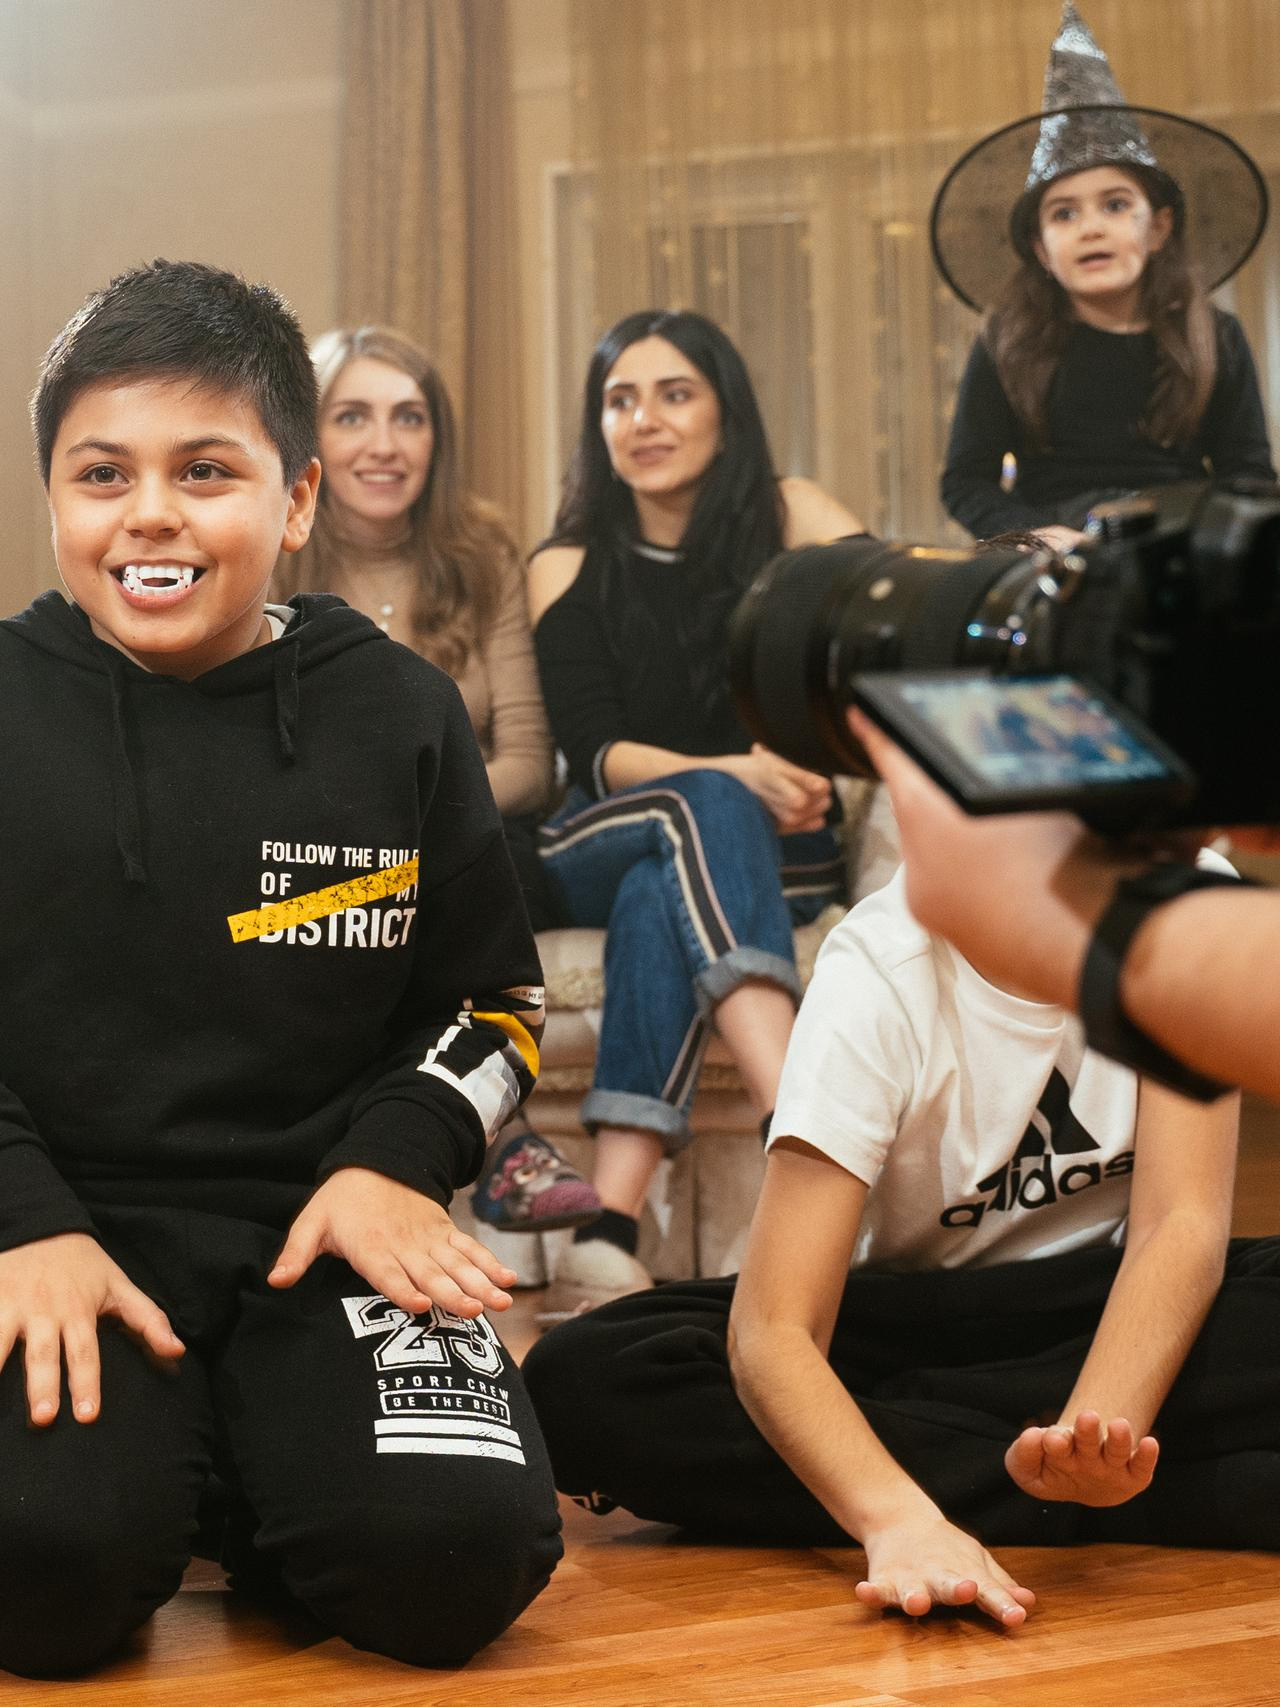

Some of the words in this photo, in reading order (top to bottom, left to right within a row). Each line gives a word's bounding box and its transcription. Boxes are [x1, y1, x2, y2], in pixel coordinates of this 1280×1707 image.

[261, 840, 336, 865] FOLLOW
[342, 846, 373, 868] THE
[260, 871, 292, 896] OF
[376, 1375, 454, 1391] SPORT
[466, 1378, 509, 1402] CREW
[392, 1396, 416, 1407] BE
[430, 1396, 463, 1408] THE
[472, 1399, 505, 1417] BEST
